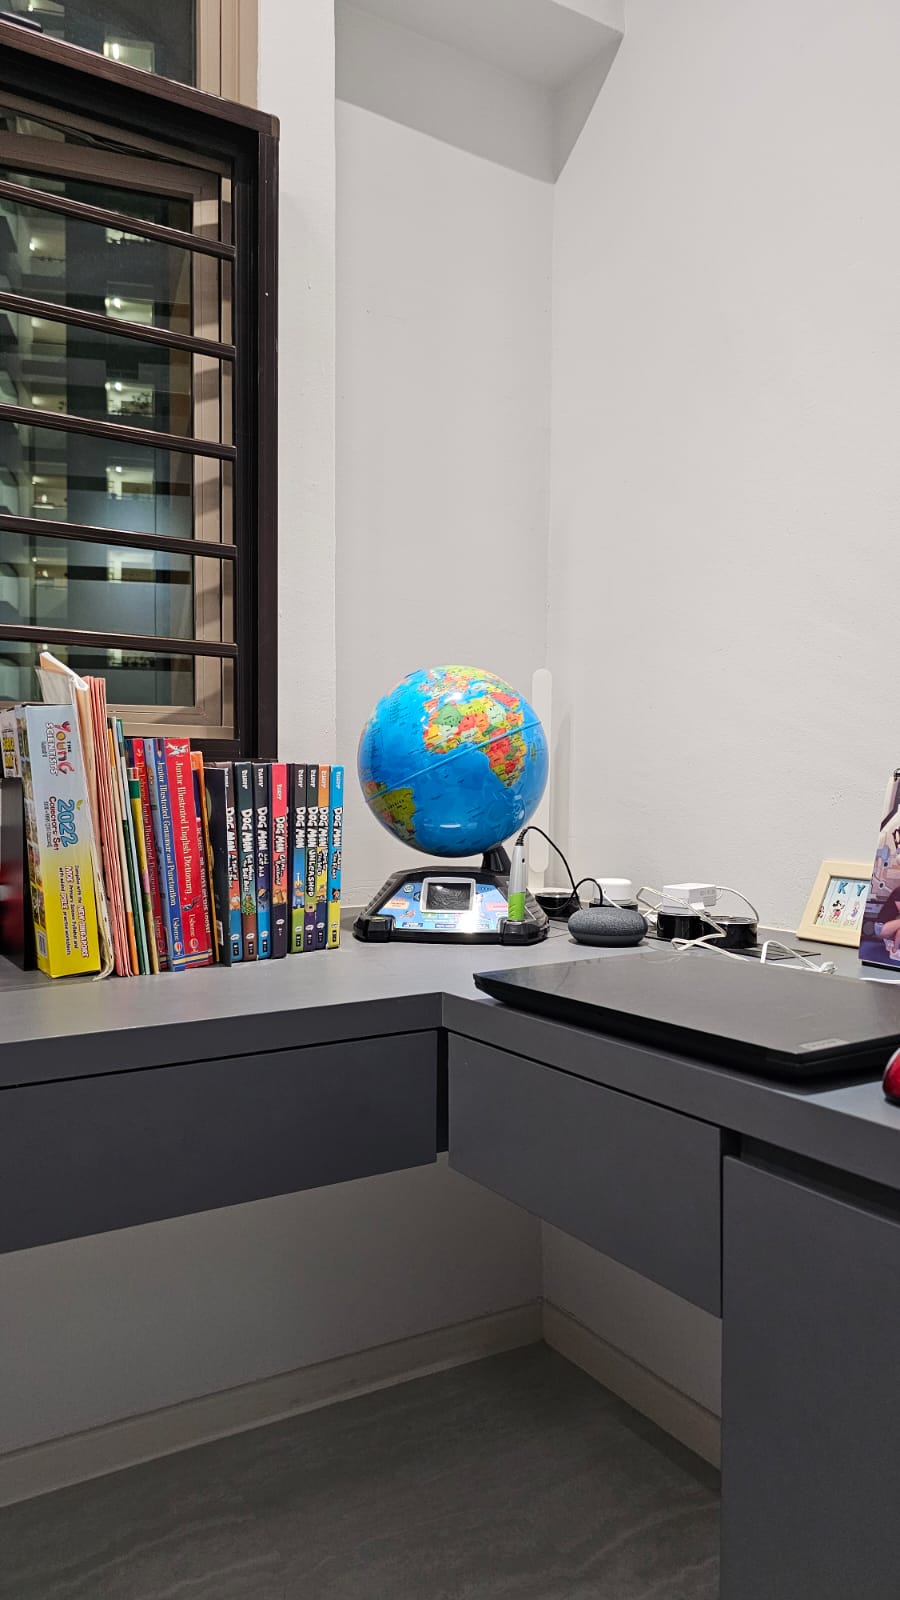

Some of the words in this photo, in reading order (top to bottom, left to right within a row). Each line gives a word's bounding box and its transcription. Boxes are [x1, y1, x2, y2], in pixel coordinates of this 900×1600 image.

[157, 760, 166, 783] Junior
[175, 761, 184, 785] Junior
[159, 784, 169, 820] Illustrated
[177, 787, 189, 824] Illustrated
[57, 799, 79, 848] 2022
[241, 808, 253, 831] DOG
[257, 806, 268, 828] DOG
[275, 816, 286, 834] DOG
[296, 806, 307, 828] DOG
[307, 806, 319, 828] DOG
[319, 806, 329, 828] DOG
[333, 807, 343, 828] DOG
[163, 820, 172, 853] Grammar
[180, 826, 191, 854] English
[241, 831, 253, 853] MAN
[257, 829, 268, 851] MAN
[275, 835, 286, 853] MAN
[295, 828, 306, 849] MAN
[307, 828, 318, 849] MAN
[318, 828, 329, 848] MAN
[333, 829, 342, 848] MAN
[65, 866, 74, 883] MOE
[183, 855, 193, 895] Dictionary
[307, 849, 317, 898] UNLEASHED
[167, 864, 177, 907] Punctuation
[838, 881, 849, 895] K
[856, 883, 866, 897] Y
[77, 905, 86, 921] NEW
[172, 917, 181, 941] Usborne
[188, 913, 197, 938] Usborne
